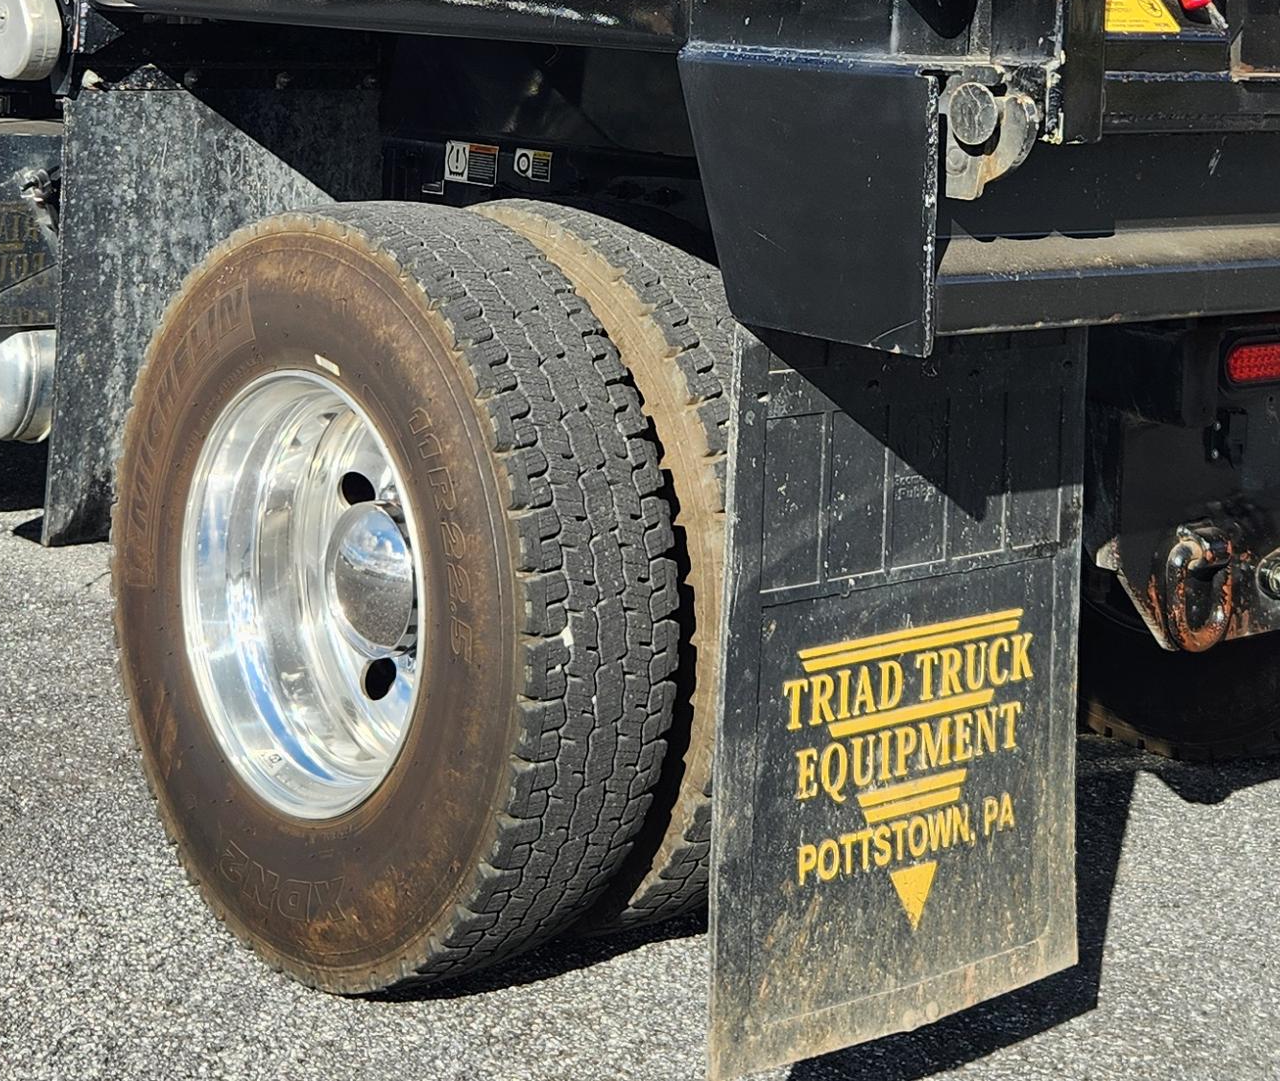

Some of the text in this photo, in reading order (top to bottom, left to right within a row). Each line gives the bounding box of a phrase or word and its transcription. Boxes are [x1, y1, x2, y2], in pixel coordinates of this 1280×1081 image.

[783, 632, 1034, 732] TRIAD TRUCK
[794, 700, 1021, 804] EQUIPMENT
[797, 792, 1016, 886] POTTSTOWN, PA
